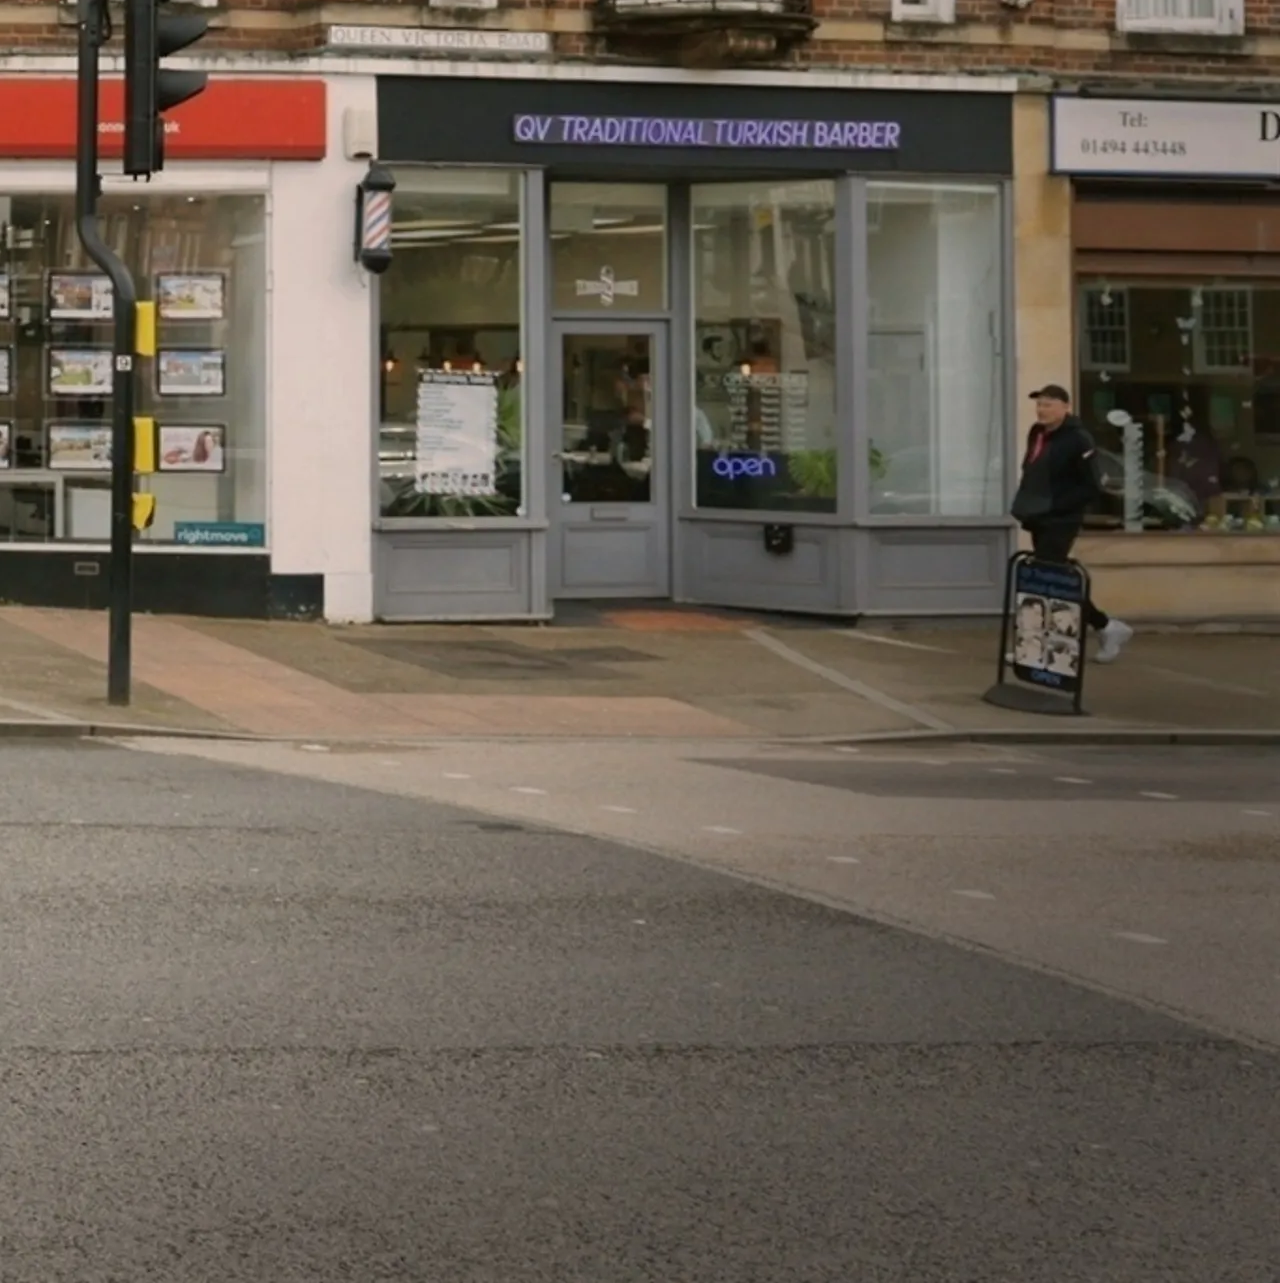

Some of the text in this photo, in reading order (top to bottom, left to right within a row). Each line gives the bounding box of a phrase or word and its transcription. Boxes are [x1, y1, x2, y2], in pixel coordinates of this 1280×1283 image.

[333, 29, 545, 49] QUEEN VICTORIA ROAD
[1119, 111, 1149, 128] Tel:
[560, 116, 709, 145] TRADITIONAL
[713, 119, 809, 146] TURKISH
[813, 121, 901, 148] BARBER
[1081, 138, 1127, 155] 01494
[712, 457, 776, 480] open
[177, 527, 249, 544] rightmove
